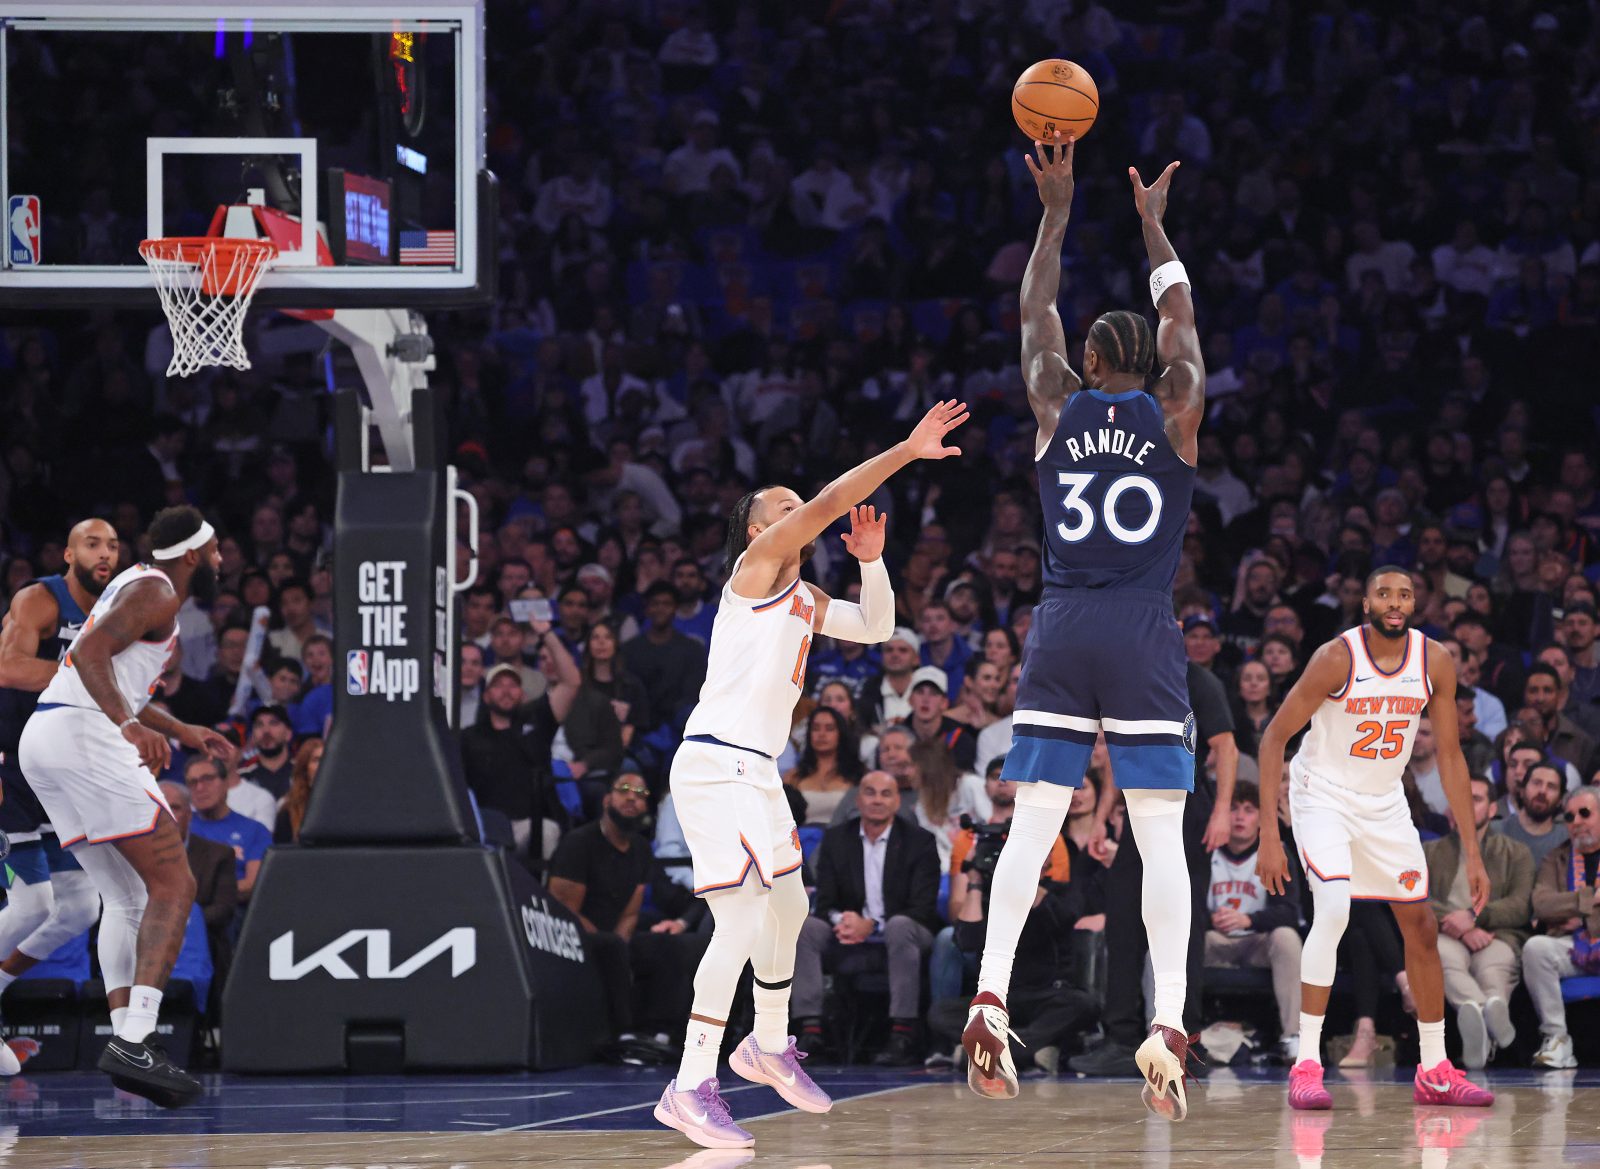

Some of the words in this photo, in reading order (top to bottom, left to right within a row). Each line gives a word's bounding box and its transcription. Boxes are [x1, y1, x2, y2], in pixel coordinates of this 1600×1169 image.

[1065, 428, 1156, 466] RANDLE
[1057, 470, 1164, 545] 30
[358, 561, 407, 603] GET
[358, 605, 408, 647] THE
[369, 650, 420, 702] App
[1345, 696, 1385, 715] NEW
[1386, 696, 1426, 715] YORK
[1350, 720, 1410, 760] 25
[521, 894, 585, 964] coinbase
[269, 927, 476, 981] KIA
